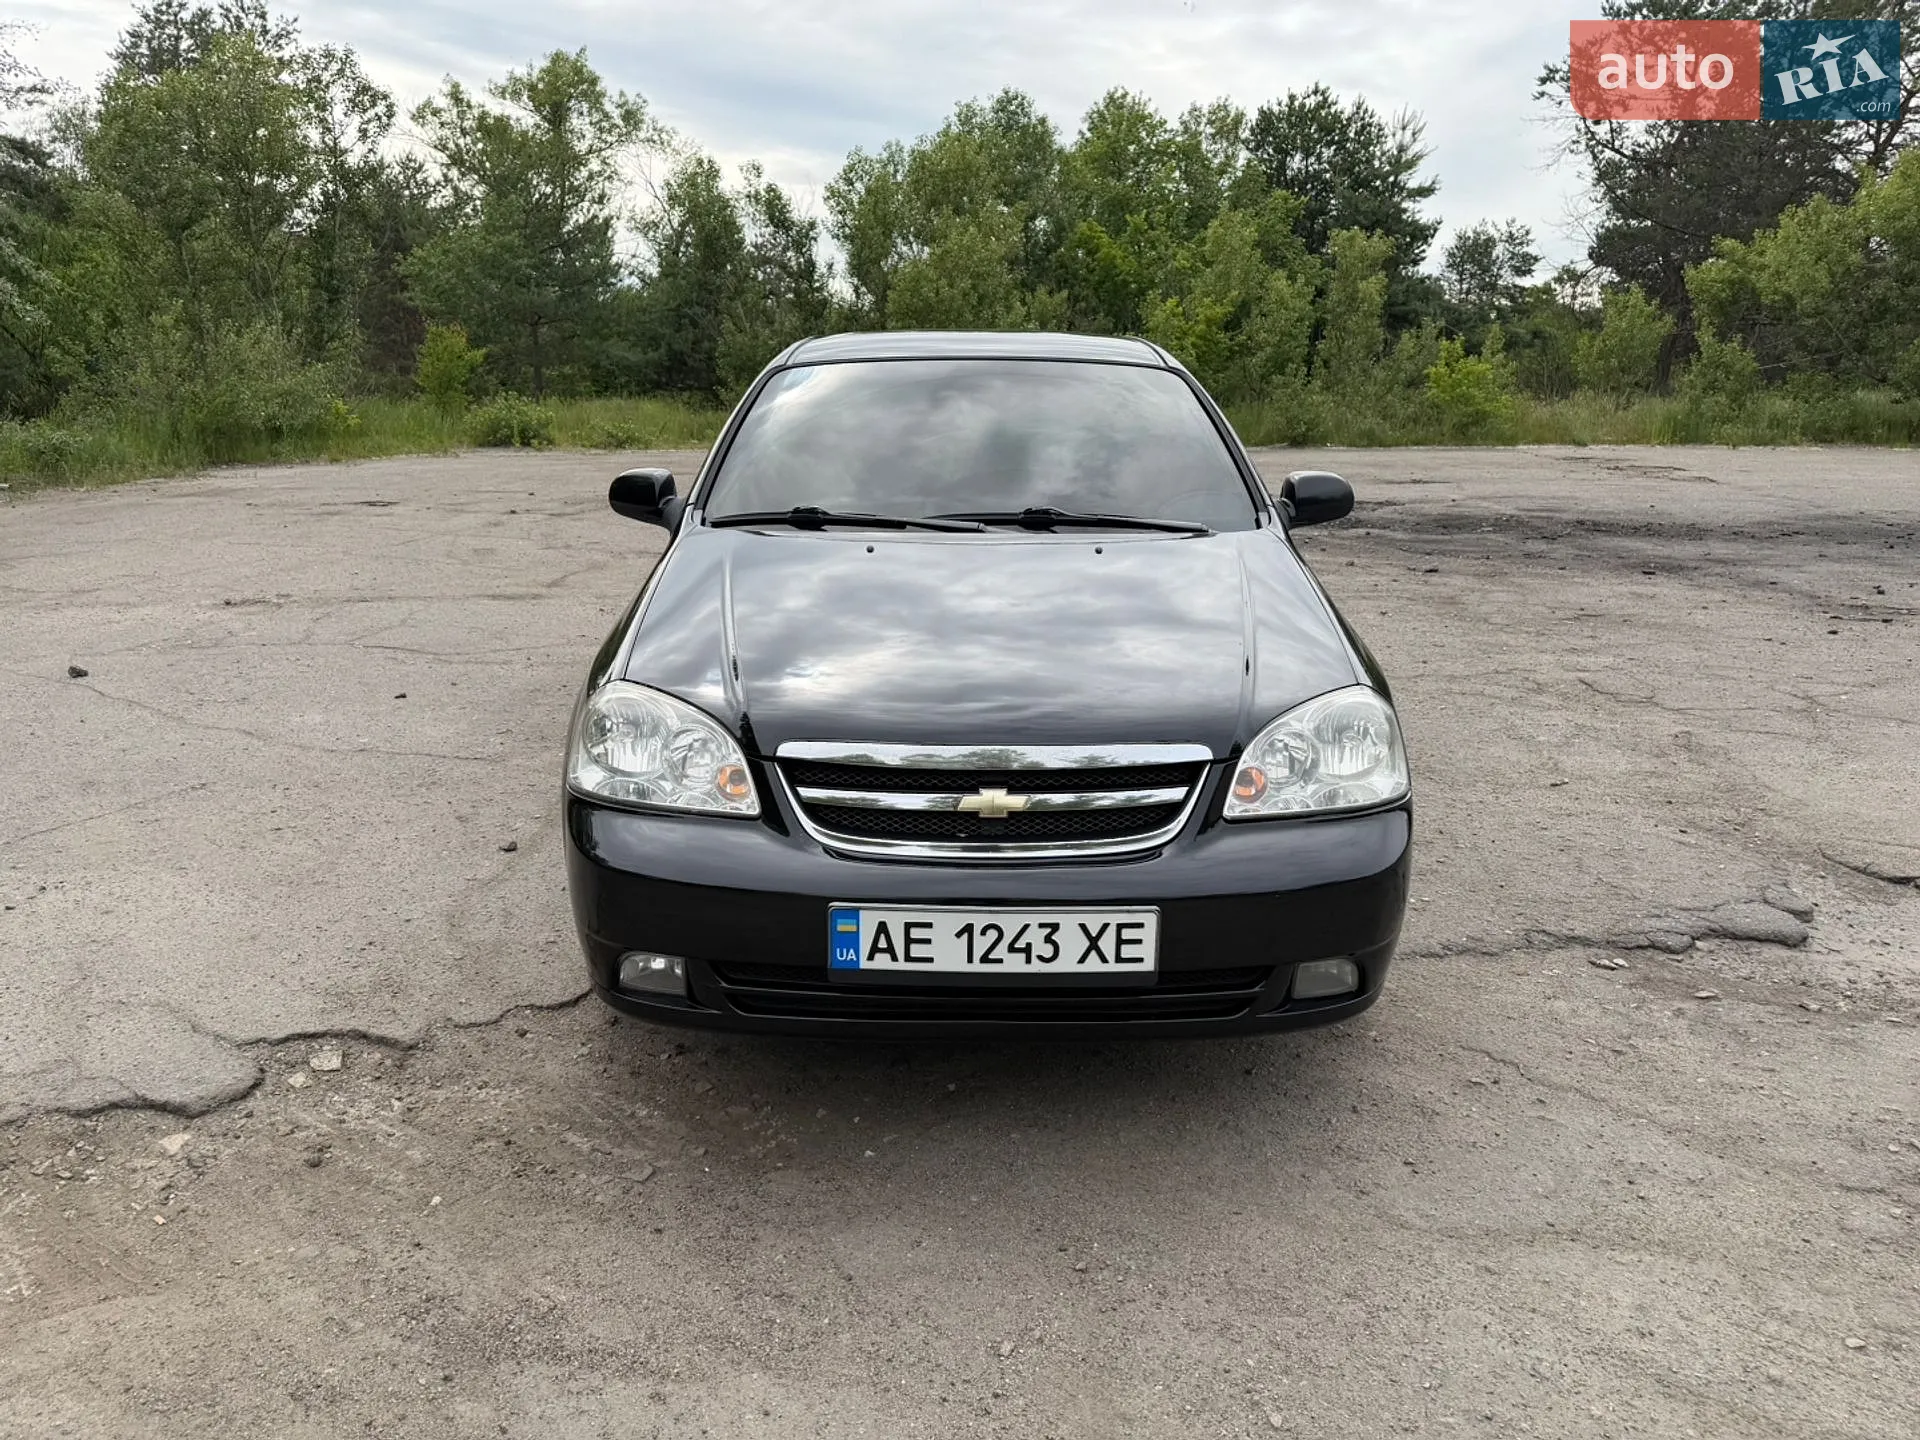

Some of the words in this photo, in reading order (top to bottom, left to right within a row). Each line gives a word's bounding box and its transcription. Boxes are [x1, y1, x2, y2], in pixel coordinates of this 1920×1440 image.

[836, 948, 857, 961] UA
[866, 920, 934, 964] AE
[954, 922, 1061, 965] 1243
[1076, 922, 1145, 964] XE
